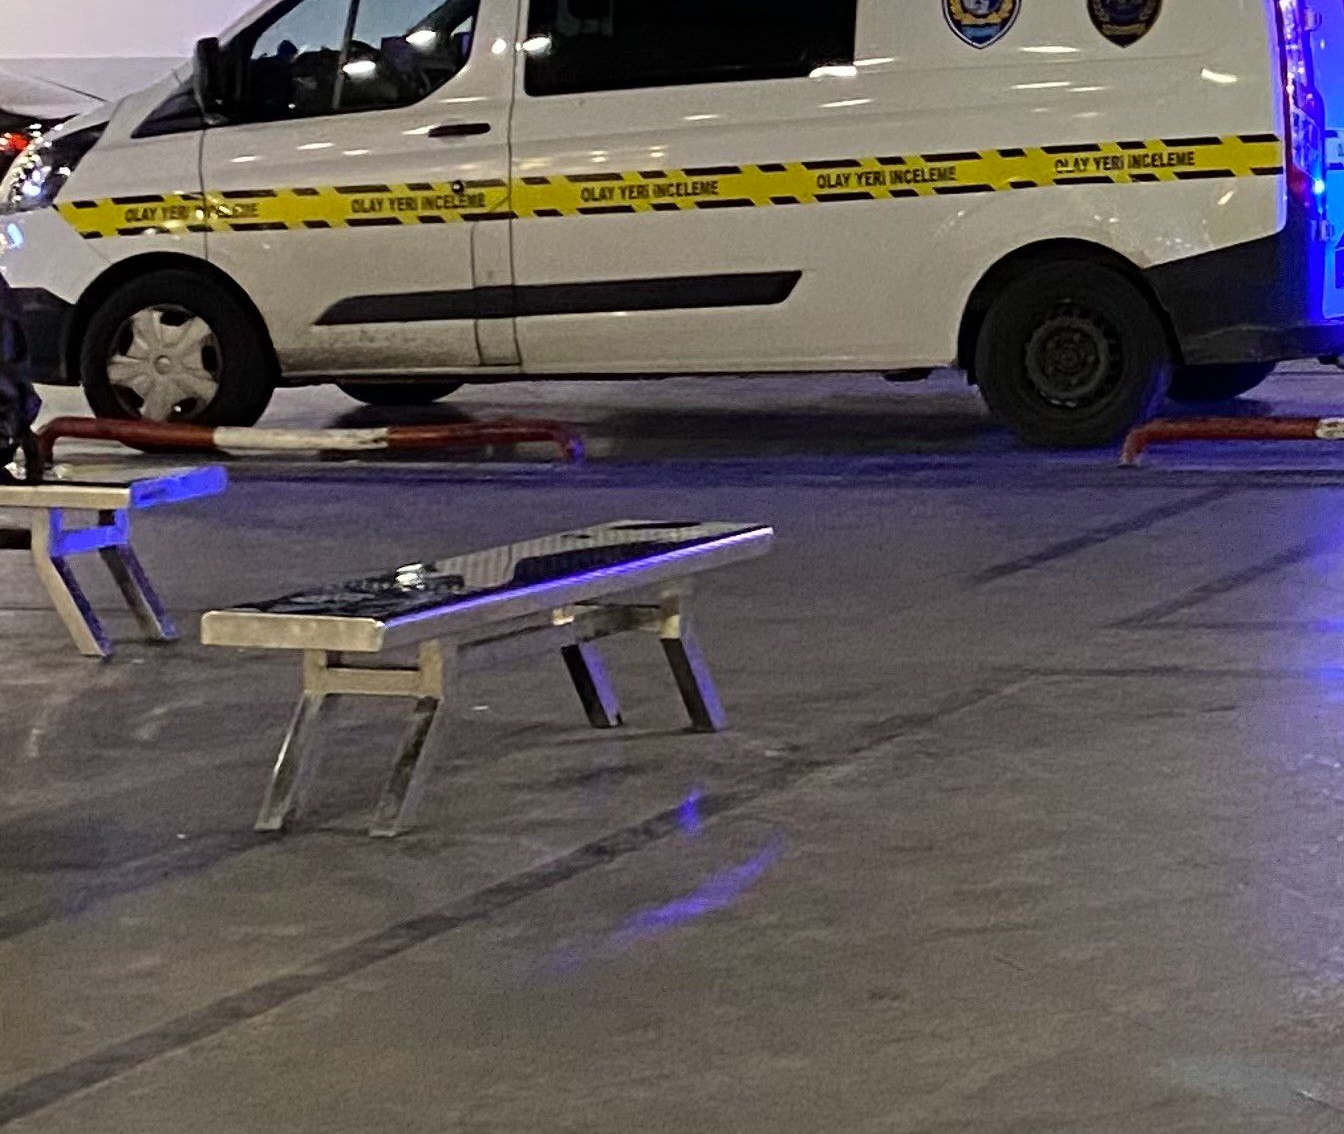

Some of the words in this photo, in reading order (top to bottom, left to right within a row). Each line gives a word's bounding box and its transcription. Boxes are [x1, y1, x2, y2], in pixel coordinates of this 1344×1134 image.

[1054, 157, 1090, 174] OLAY
[816, 173, 852, 189] OLAY
[580, 186, 615, 202] OLAY
[351, 197, 384, 213] OLAY
